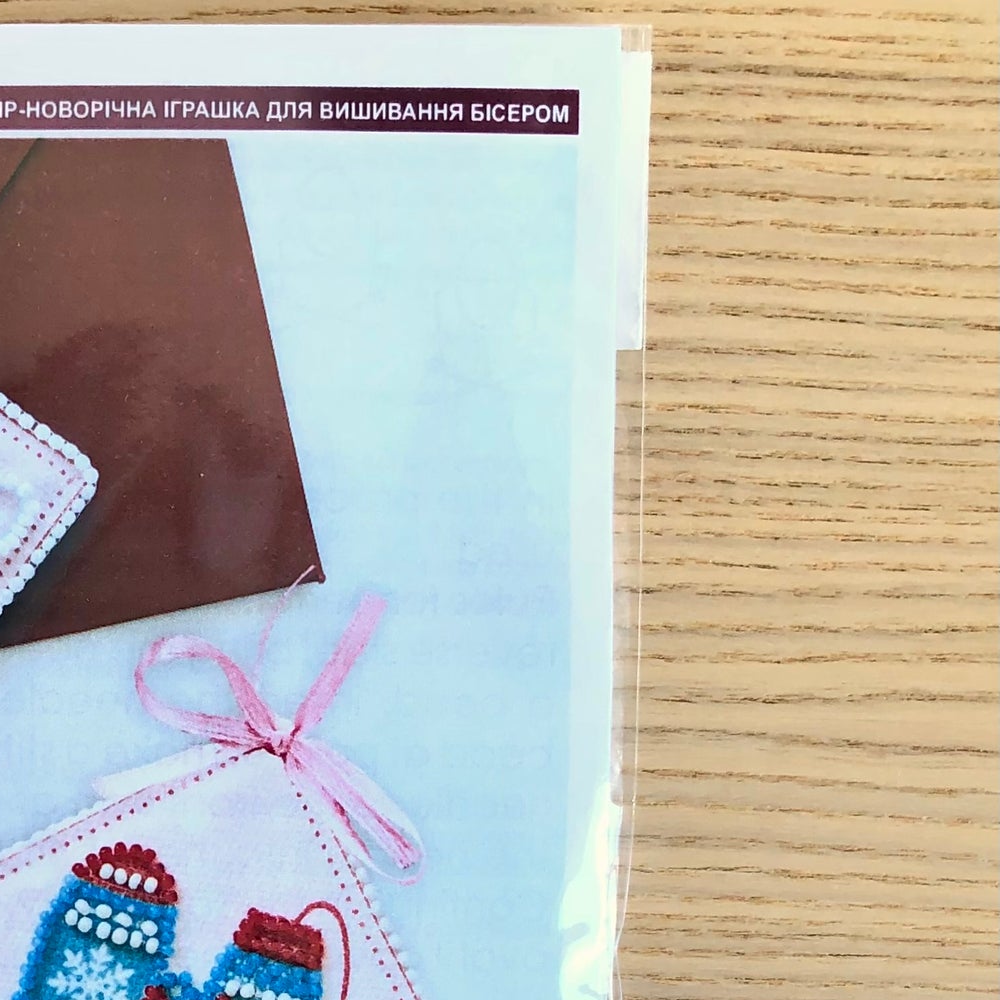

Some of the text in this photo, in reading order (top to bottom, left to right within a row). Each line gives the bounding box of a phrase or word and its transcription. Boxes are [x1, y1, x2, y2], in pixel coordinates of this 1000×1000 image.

[164, 100, 260, 119] ІГРАШКА
[266, 101, 312, 123] ДЛЯ
[319, 101, 464, 121] ВИШИВАННЯ
[470, 103, 569, 124] БІСЕРОМ
